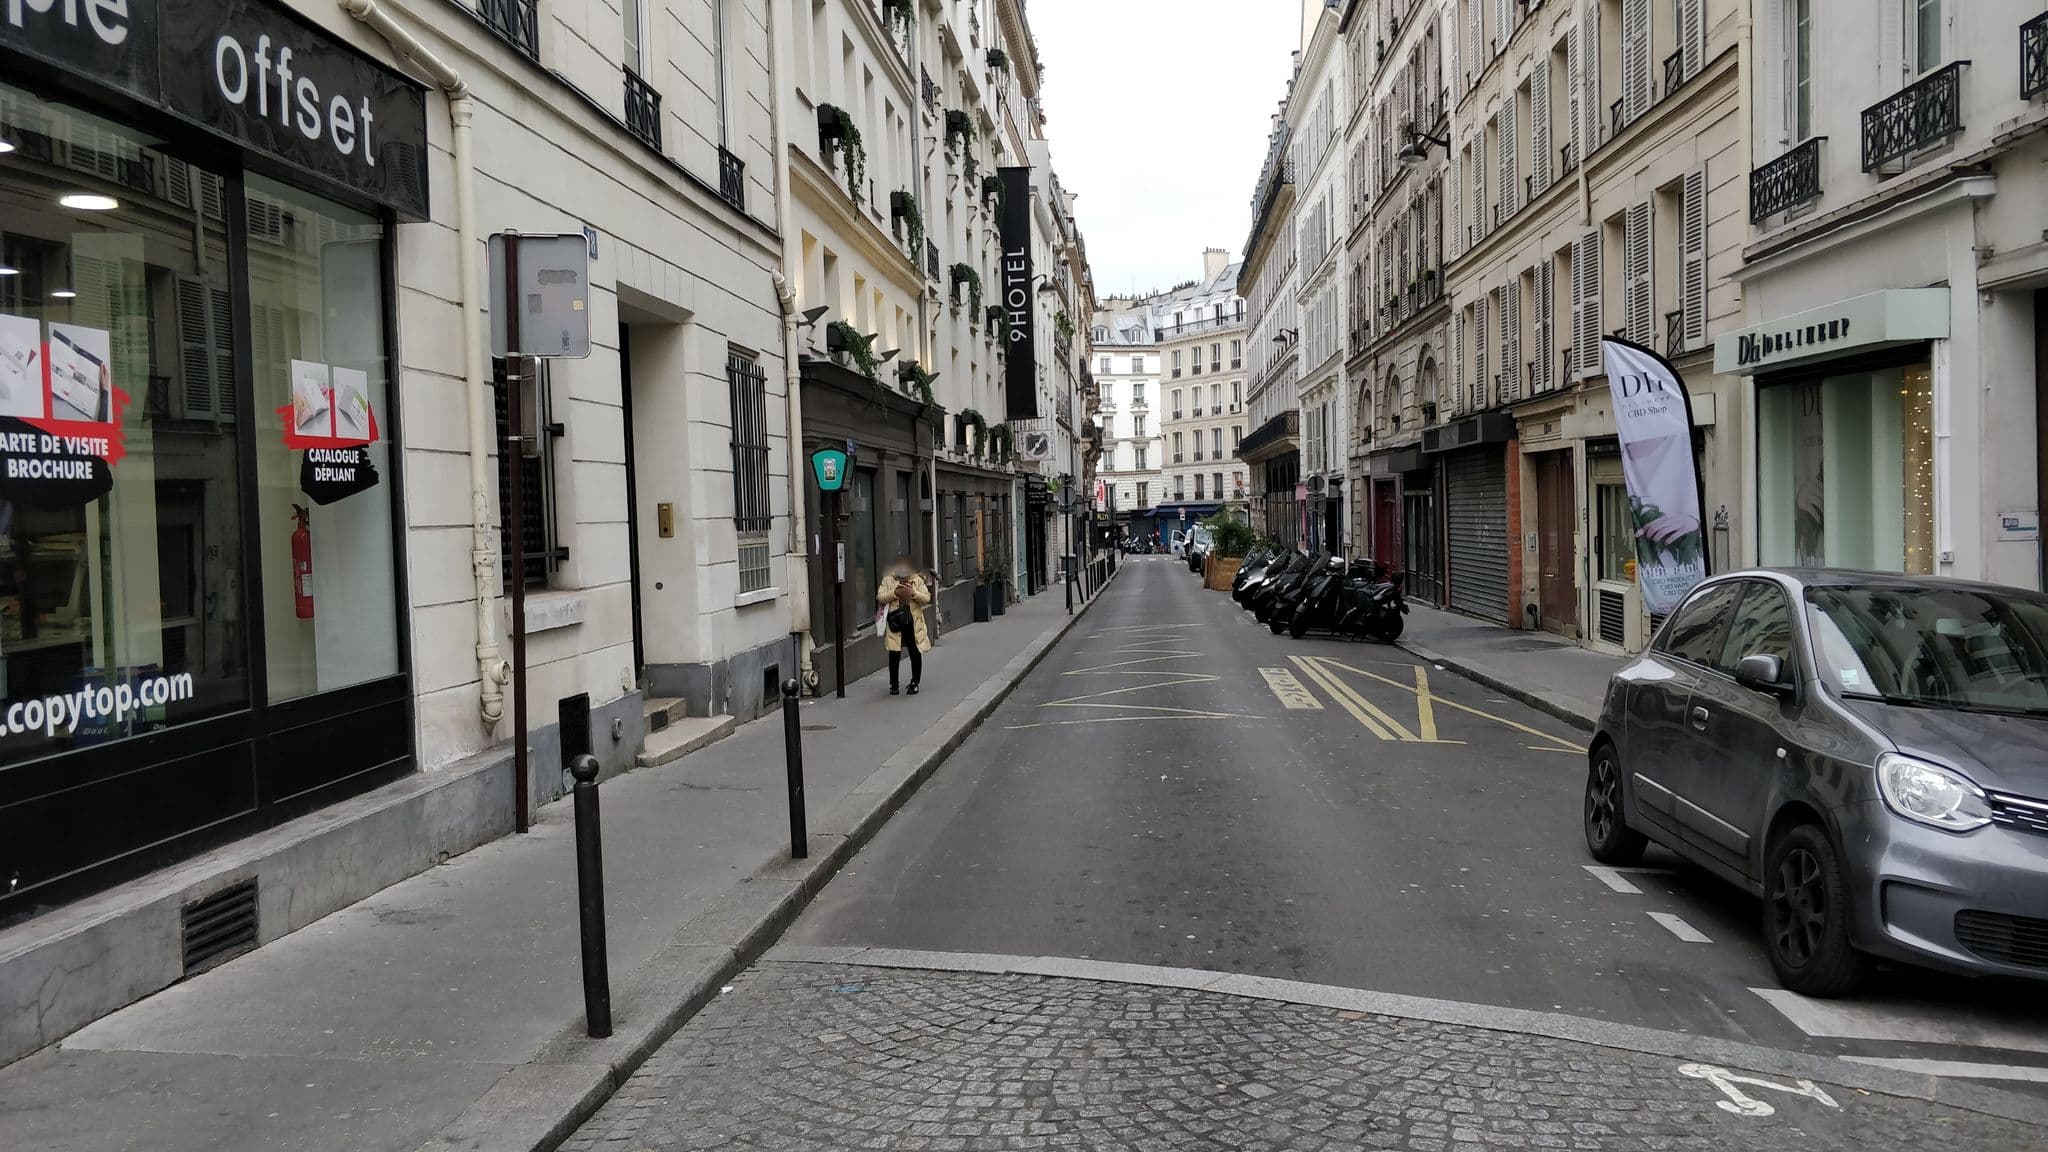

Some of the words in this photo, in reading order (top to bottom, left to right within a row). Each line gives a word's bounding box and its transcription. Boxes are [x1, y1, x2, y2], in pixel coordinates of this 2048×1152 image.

[216, 34, 375, 167] offset
[1007, 247, 1027, 342] 9HOTEL
[1628, 409, 1646, 418] CBD
[1648, 406, 1667, 415] Shop
[0, 432, 37, 453] ARTE
[41, 435, 61, 454] DE
[64, 436, 109, 456] VISITE
[309, 448, 360, 463] CATALOGUE
[7, 458, 94, 479] BROCHURE
[315, 464, 355, 481] DÉPLIANT
